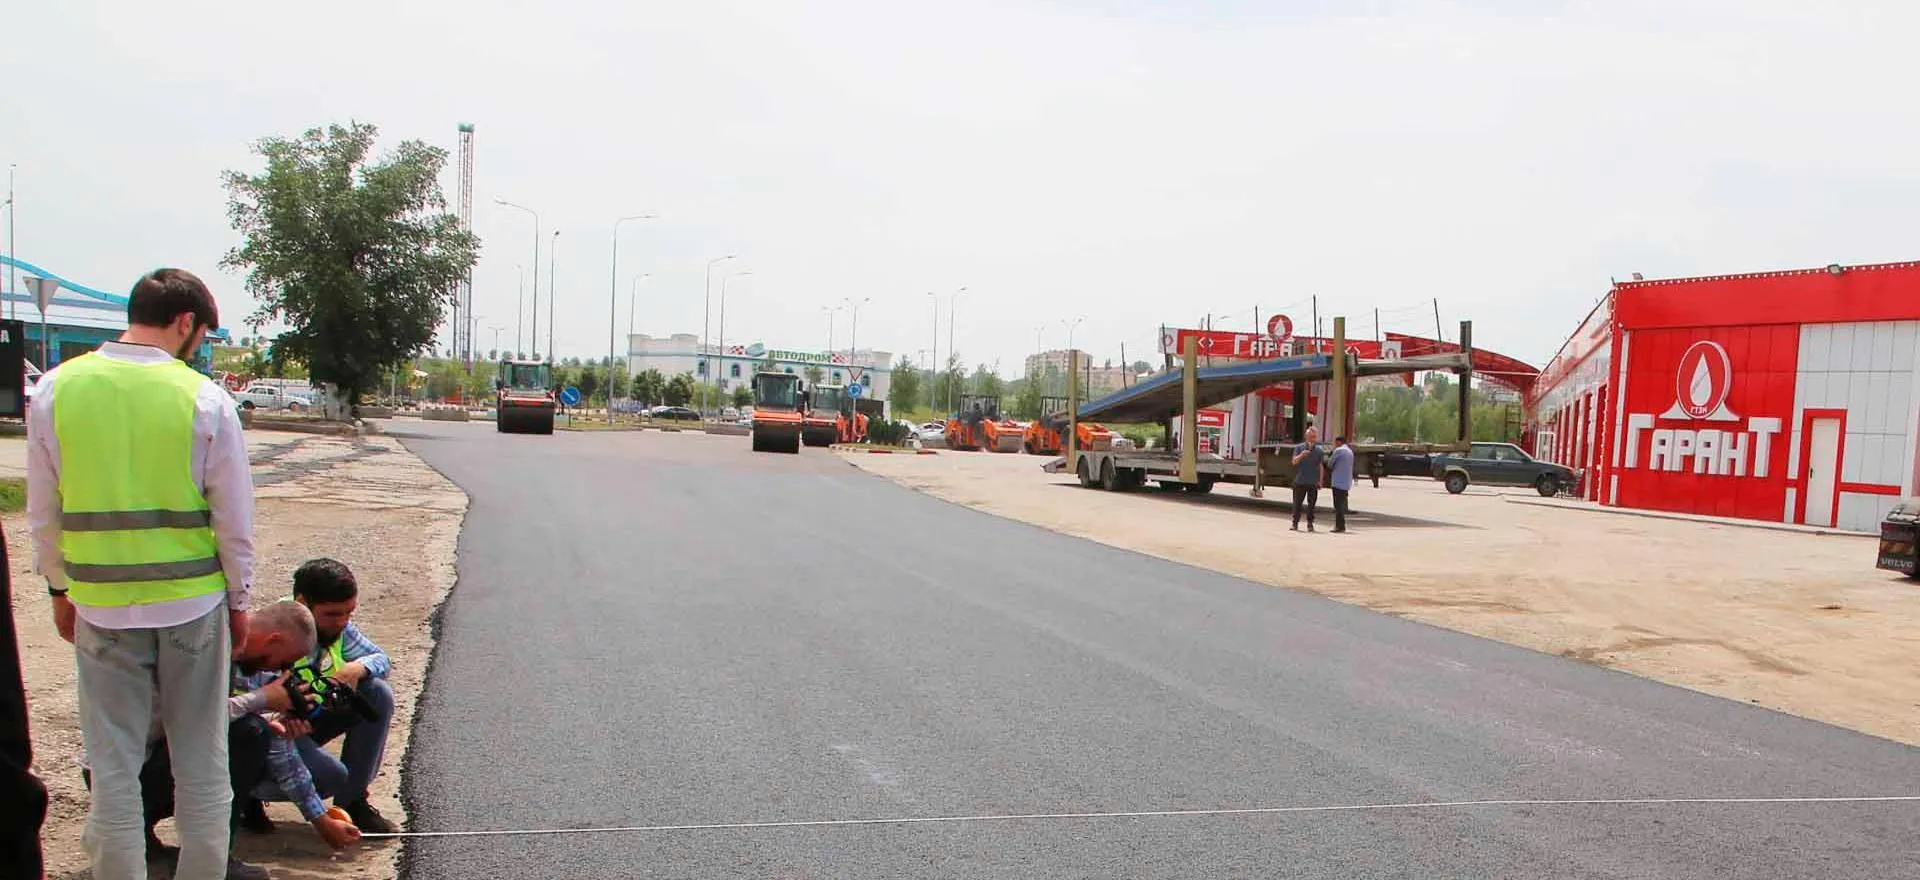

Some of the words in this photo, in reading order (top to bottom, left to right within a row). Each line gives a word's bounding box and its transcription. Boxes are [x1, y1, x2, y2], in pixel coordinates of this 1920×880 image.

[769, 350, 831, 361] АВТОДРОМ
[1234, 335, 1327, 358] ГАРАТ
[1625, 413, 1782, 478] ГАРАНТ
